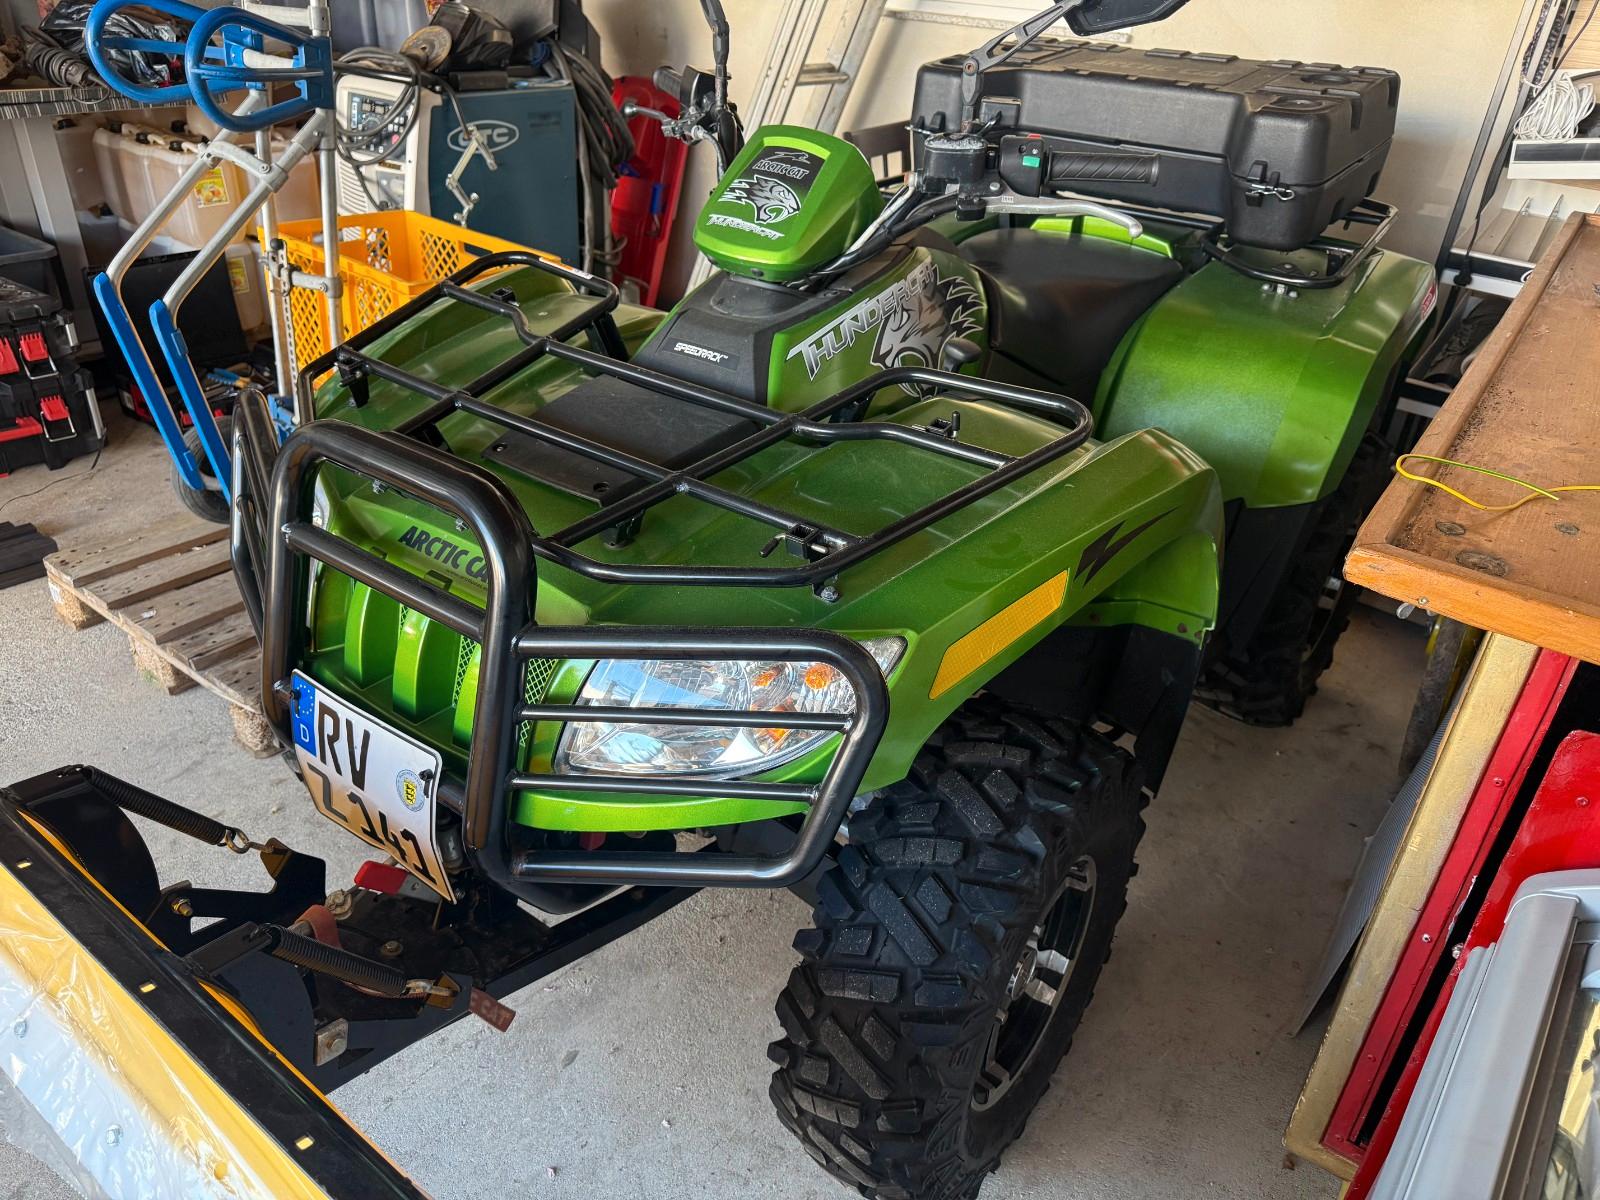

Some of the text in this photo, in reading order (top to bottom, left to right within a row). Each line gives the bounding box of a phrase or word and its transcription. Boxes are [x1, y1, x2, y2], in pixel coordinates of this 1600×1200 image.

[752, 159, 810, 180] ARCTIC CAT
[398, 525, 470, 569] ARCTIC
[465, 555, 488, 583] CA
[300, 723, 310, 743] D
[317, 700, 371, 791] RV
